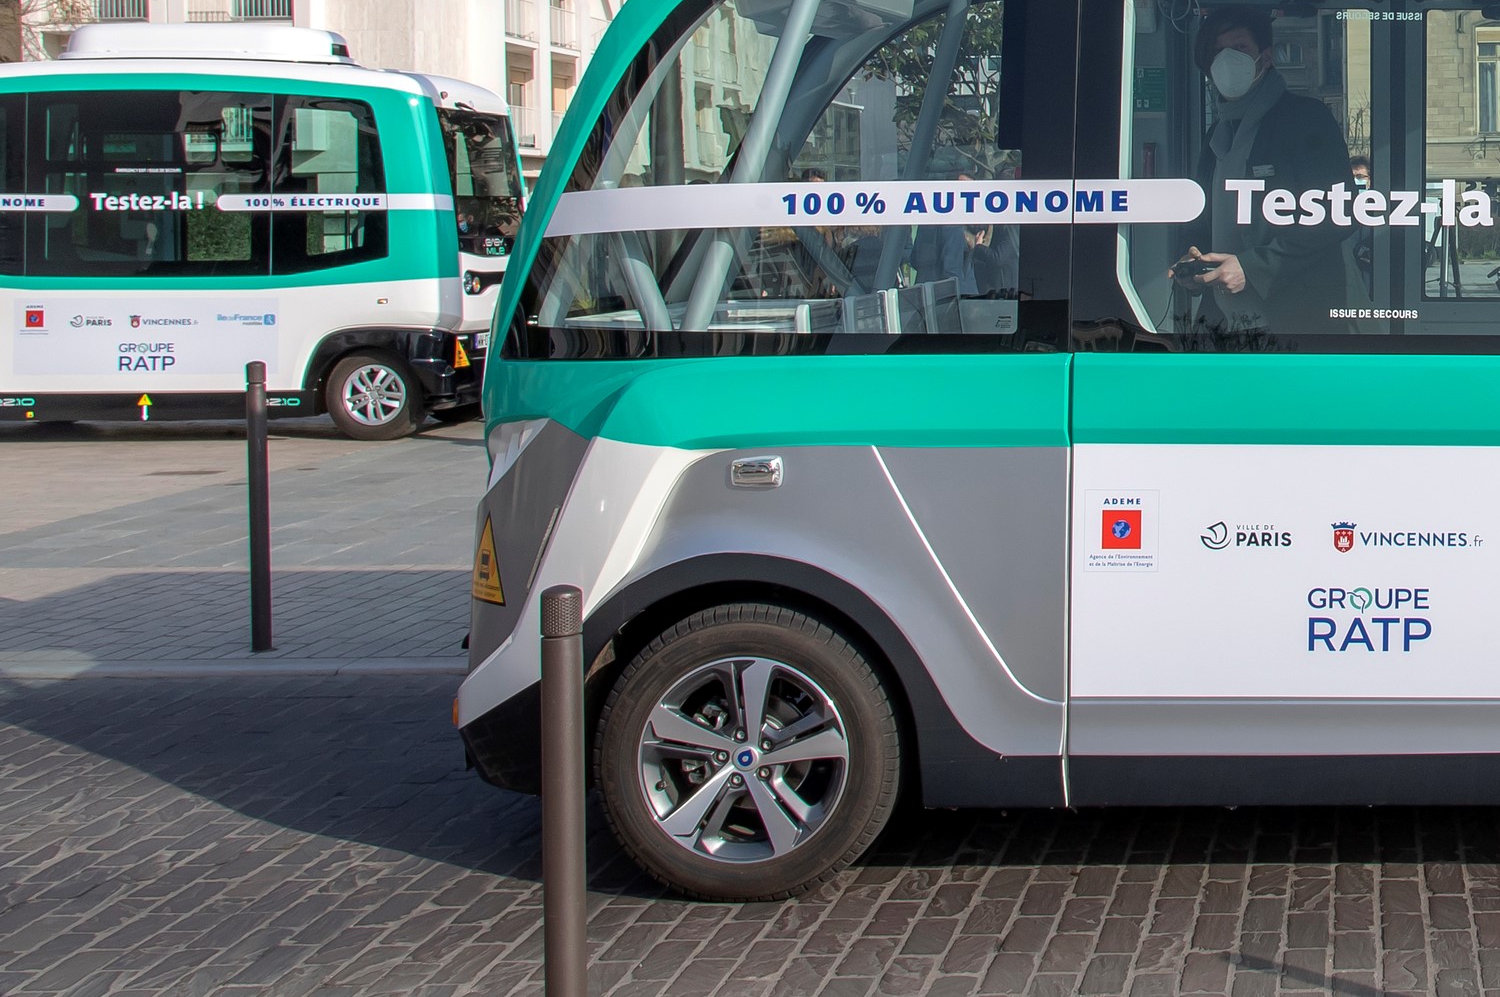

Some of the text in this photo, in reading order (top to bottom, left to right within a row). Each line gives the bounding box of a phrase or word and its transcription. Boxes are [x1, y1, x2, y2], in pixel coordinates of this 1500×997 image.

[90, 191, 193, 211] Testez-la
[245, 198, 270, 207] 100
[290, 196, 381, 208] ÉLECTRIQUE
[782, 190, 1130, 216] 100 % AUTONOME
[1225, 178, 1494, 228] Testez-la
[1329, 308, 1419, 320] ISSUE DE SECOURS
[86, 319, 112, 327] PARIS
[118, 342, 175, 354] GROUPE
[118, 355, 176, 372] RATP
[1103, 497, 1142, 505] ADEME
[1235, 531, 1293, 547] PARIS
[1307, 587, 1430, 611] GROUPE
[1307, 616, 1433, 652] RATP
